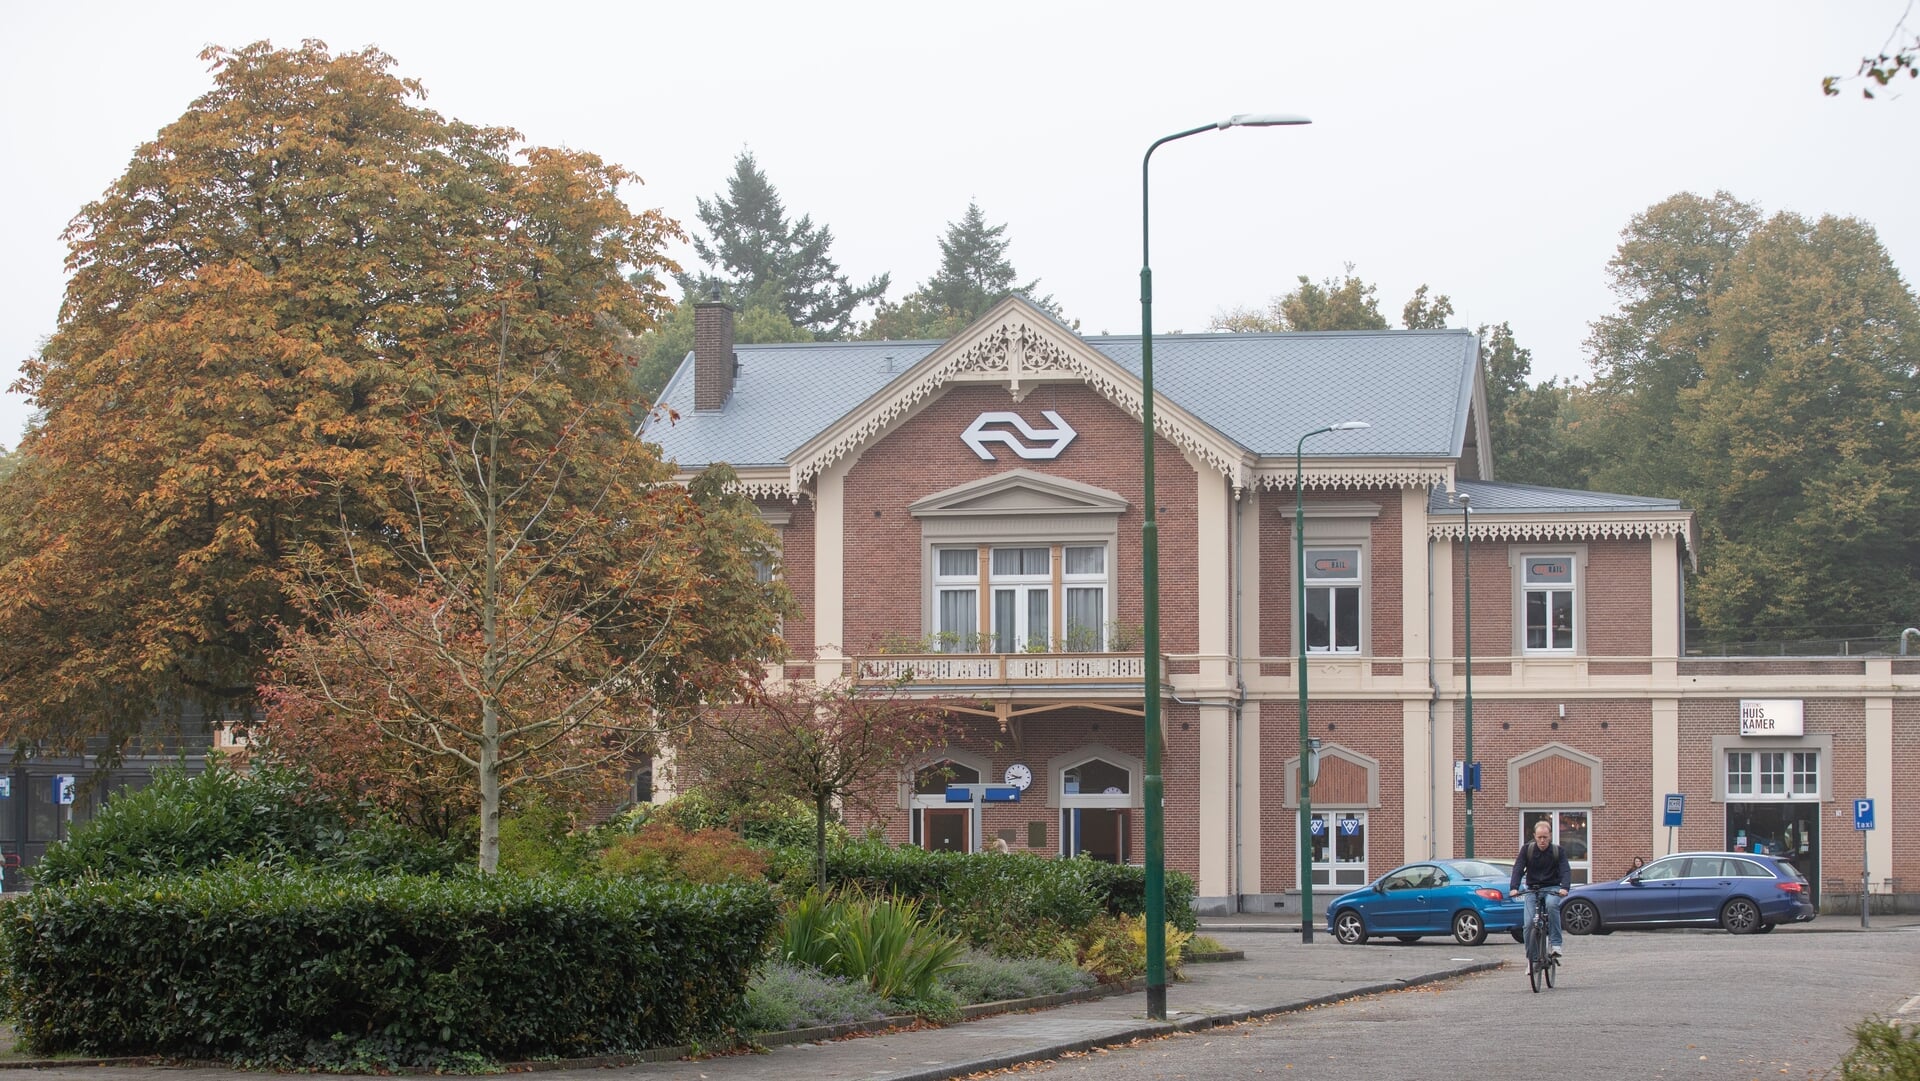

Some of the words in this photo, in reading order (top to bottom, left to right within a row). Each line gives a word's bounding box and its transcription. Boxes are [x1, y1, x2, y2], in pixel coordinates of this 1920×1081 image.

[1742, 708, 1765, 719] HUIS
[1742, 719, 1775, 730] KAMER
[1858, 801, 1870, 818] P
[1856, 821, 1873, 829] taxi
